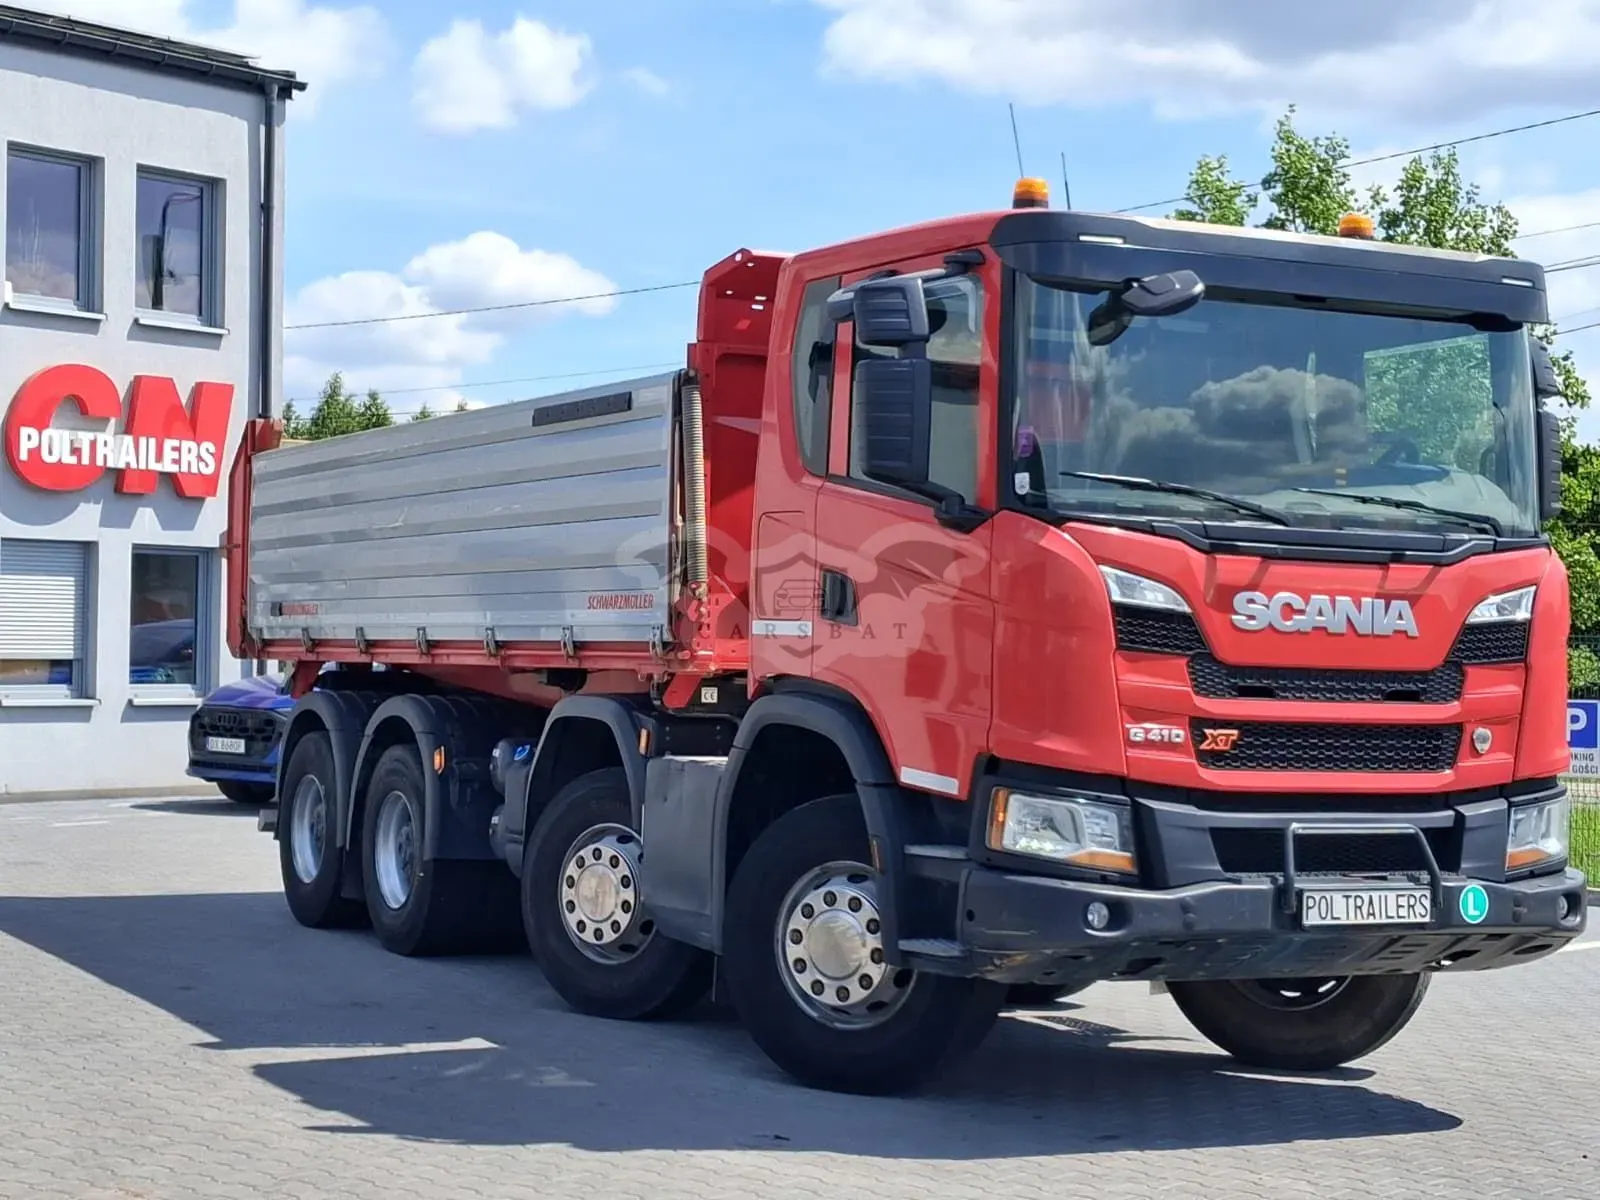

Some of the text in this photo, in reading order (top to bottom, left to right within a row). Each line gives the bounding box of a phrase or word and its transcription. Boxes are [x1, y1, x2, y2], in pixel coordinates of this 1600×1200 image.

[5, 363, 235, 498] CN
[18, 426, 216, 475] POLTRAILERS
[1231, 591, 1420, 637] SCANIA
[1200, 729, 1239, 751] XT
[1566, 708, 1587, 742] P
[1305, 894, 1429, 920] POLTRAILERS
[1466, 891, 1481, 917] L
